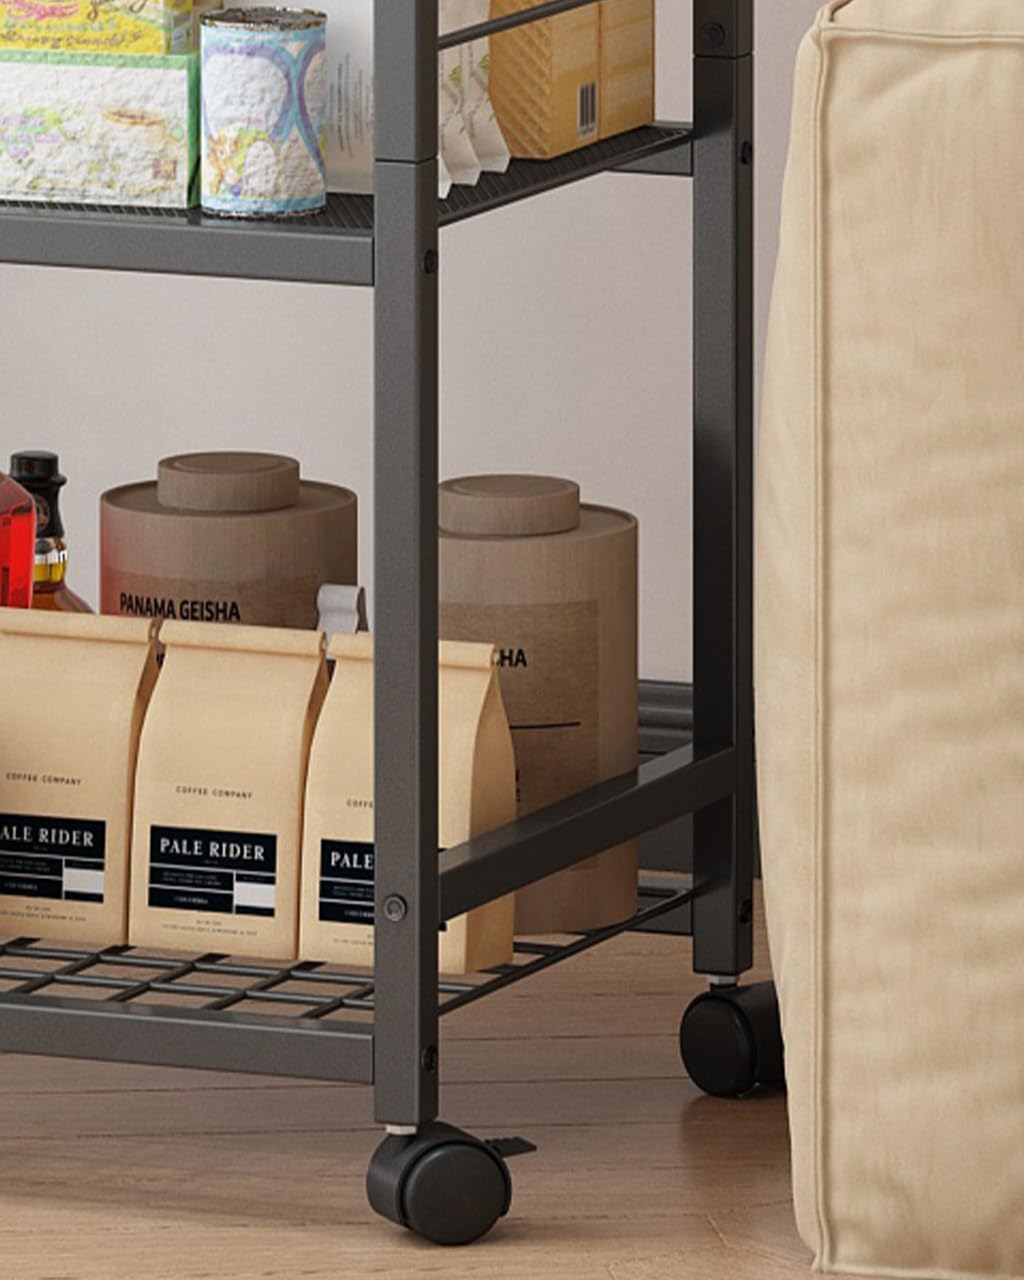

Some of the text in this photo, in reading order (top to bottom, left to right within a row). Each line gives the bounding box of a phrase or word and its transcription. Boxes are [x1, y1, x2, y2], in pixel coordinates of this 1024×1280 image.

[119, 592, 241, 621] PANAMA GEISHA
[5, 771, 82, 786] COFFEE COMPANY
[175, 785, 253, 799] COFFEE COMPANY
[37, 827, 95, 848] RIDER
[159, 836, 266, 862] PALE RIDER
[330, 850, 374, 870] PALE
